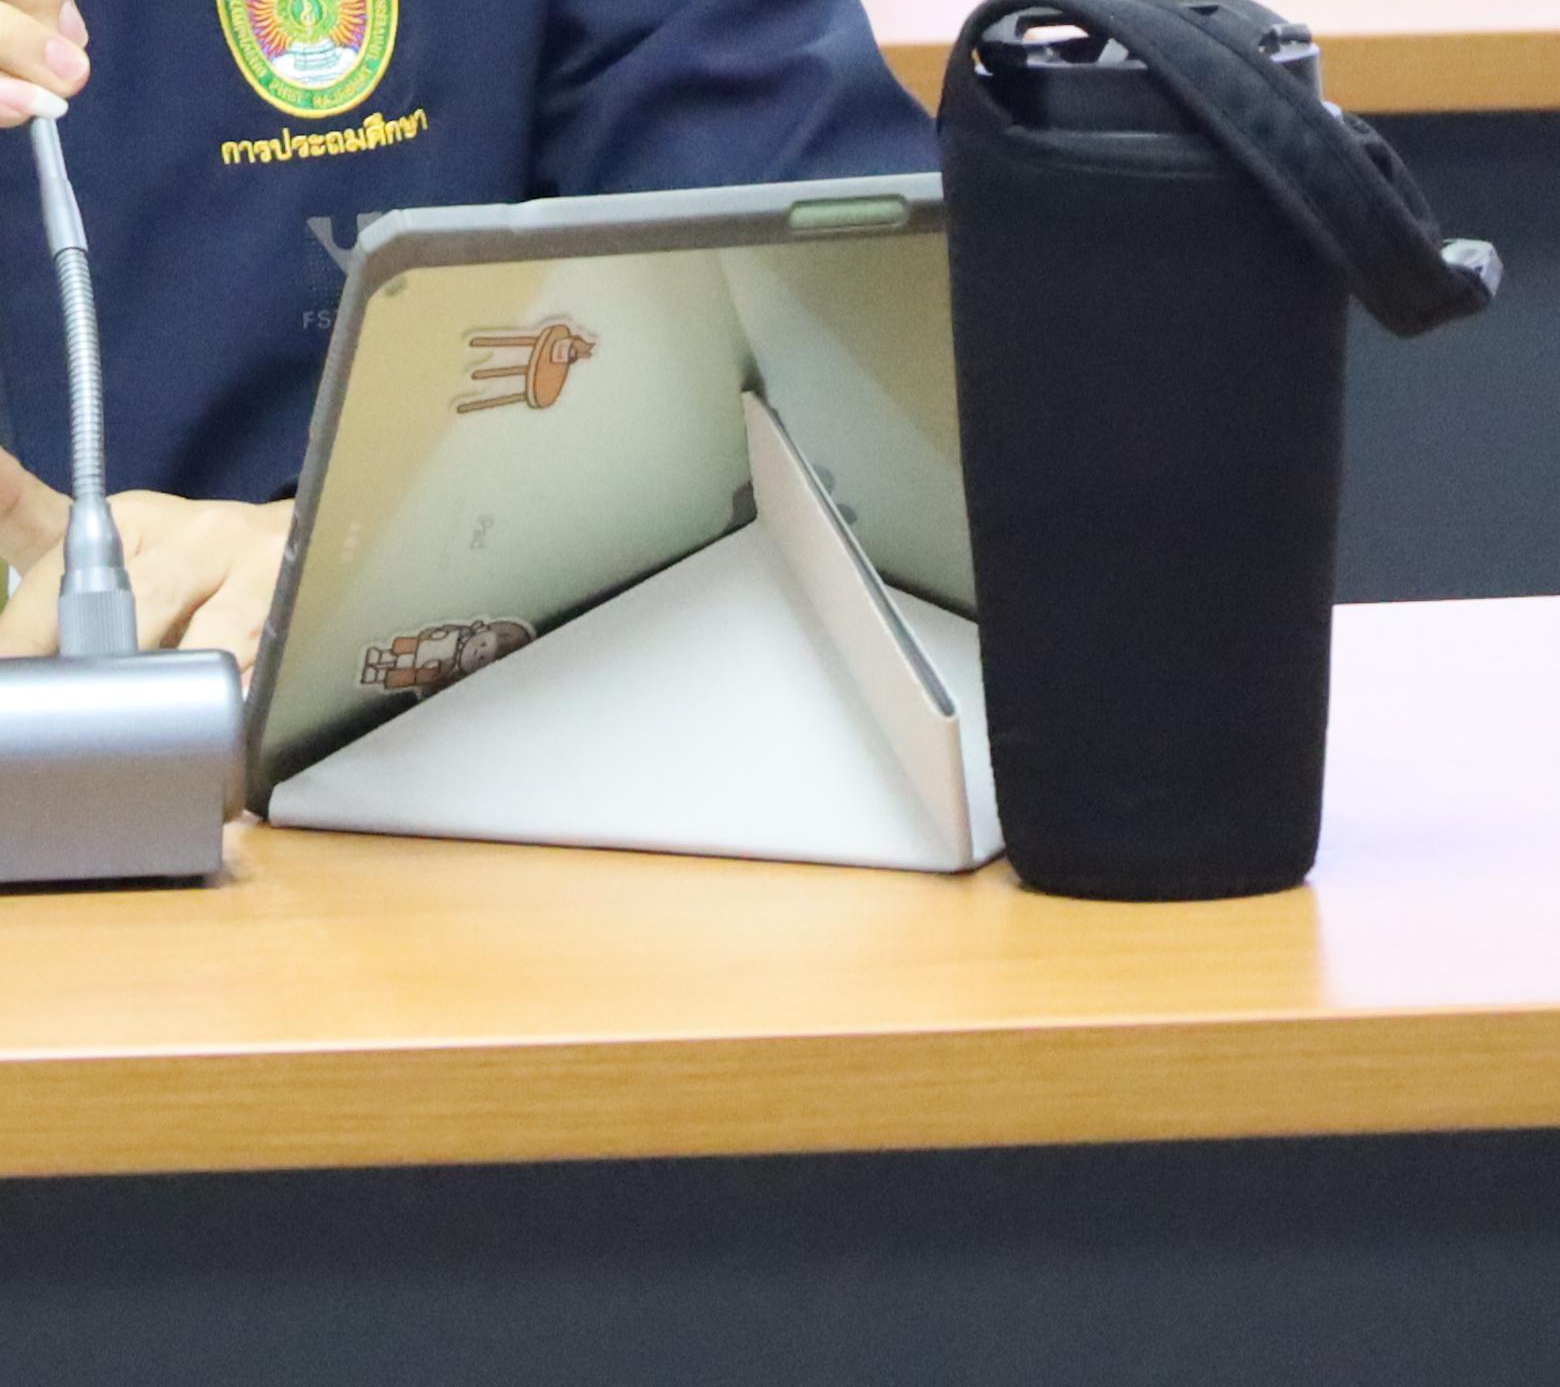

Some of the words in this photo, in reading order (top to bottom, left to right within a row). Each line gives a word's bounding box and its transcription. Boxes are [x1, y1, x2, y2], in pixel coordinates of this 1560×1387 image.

[220, 108, 429, 165] การประถมศึกษา
